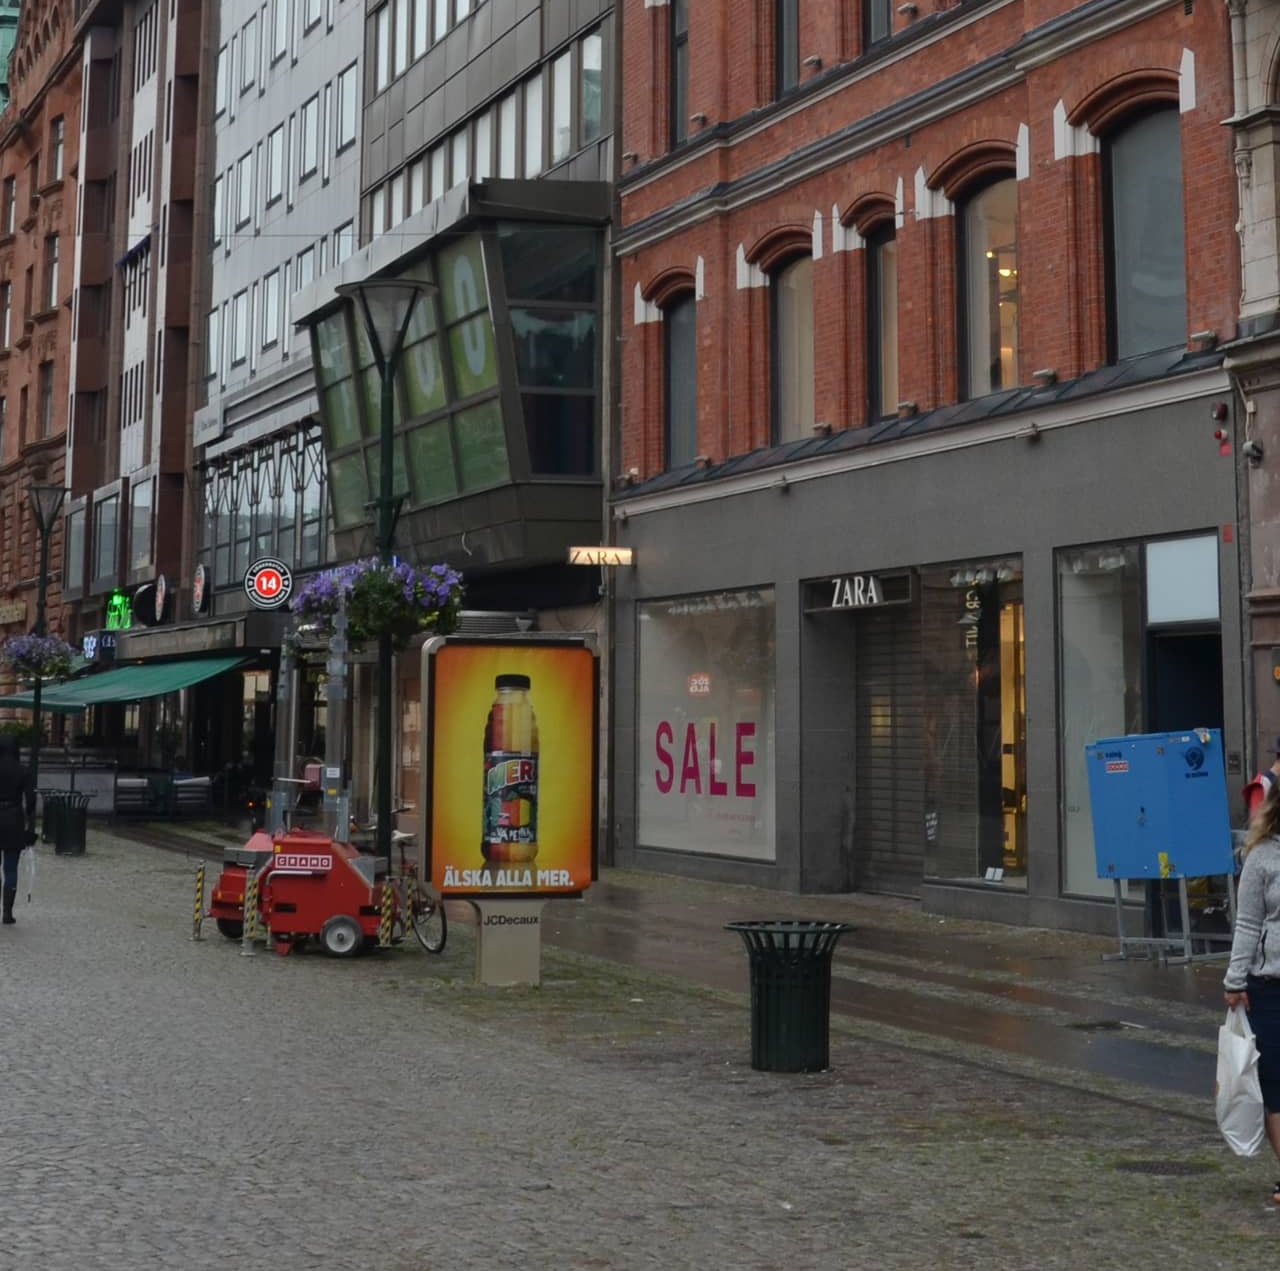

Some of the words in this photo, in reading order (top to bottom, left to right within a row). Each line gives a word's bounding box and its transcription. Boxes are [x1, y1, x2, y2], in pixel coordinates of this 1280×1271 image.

[571, 551, 621, 565] ZARA
[260, 576, 277, 590] 14
[831, 575, 879, 608] ZARA
[655, 720, 757, 798] SALE
[277, 855, 332, 868] CRAMO
[443, 865, 492, 886] ÄLSKA
[495, 869, 532, 886] ALLA
[537, 869, 575, 886] MER.
[484, 915, 539, 926] JCDecaux
